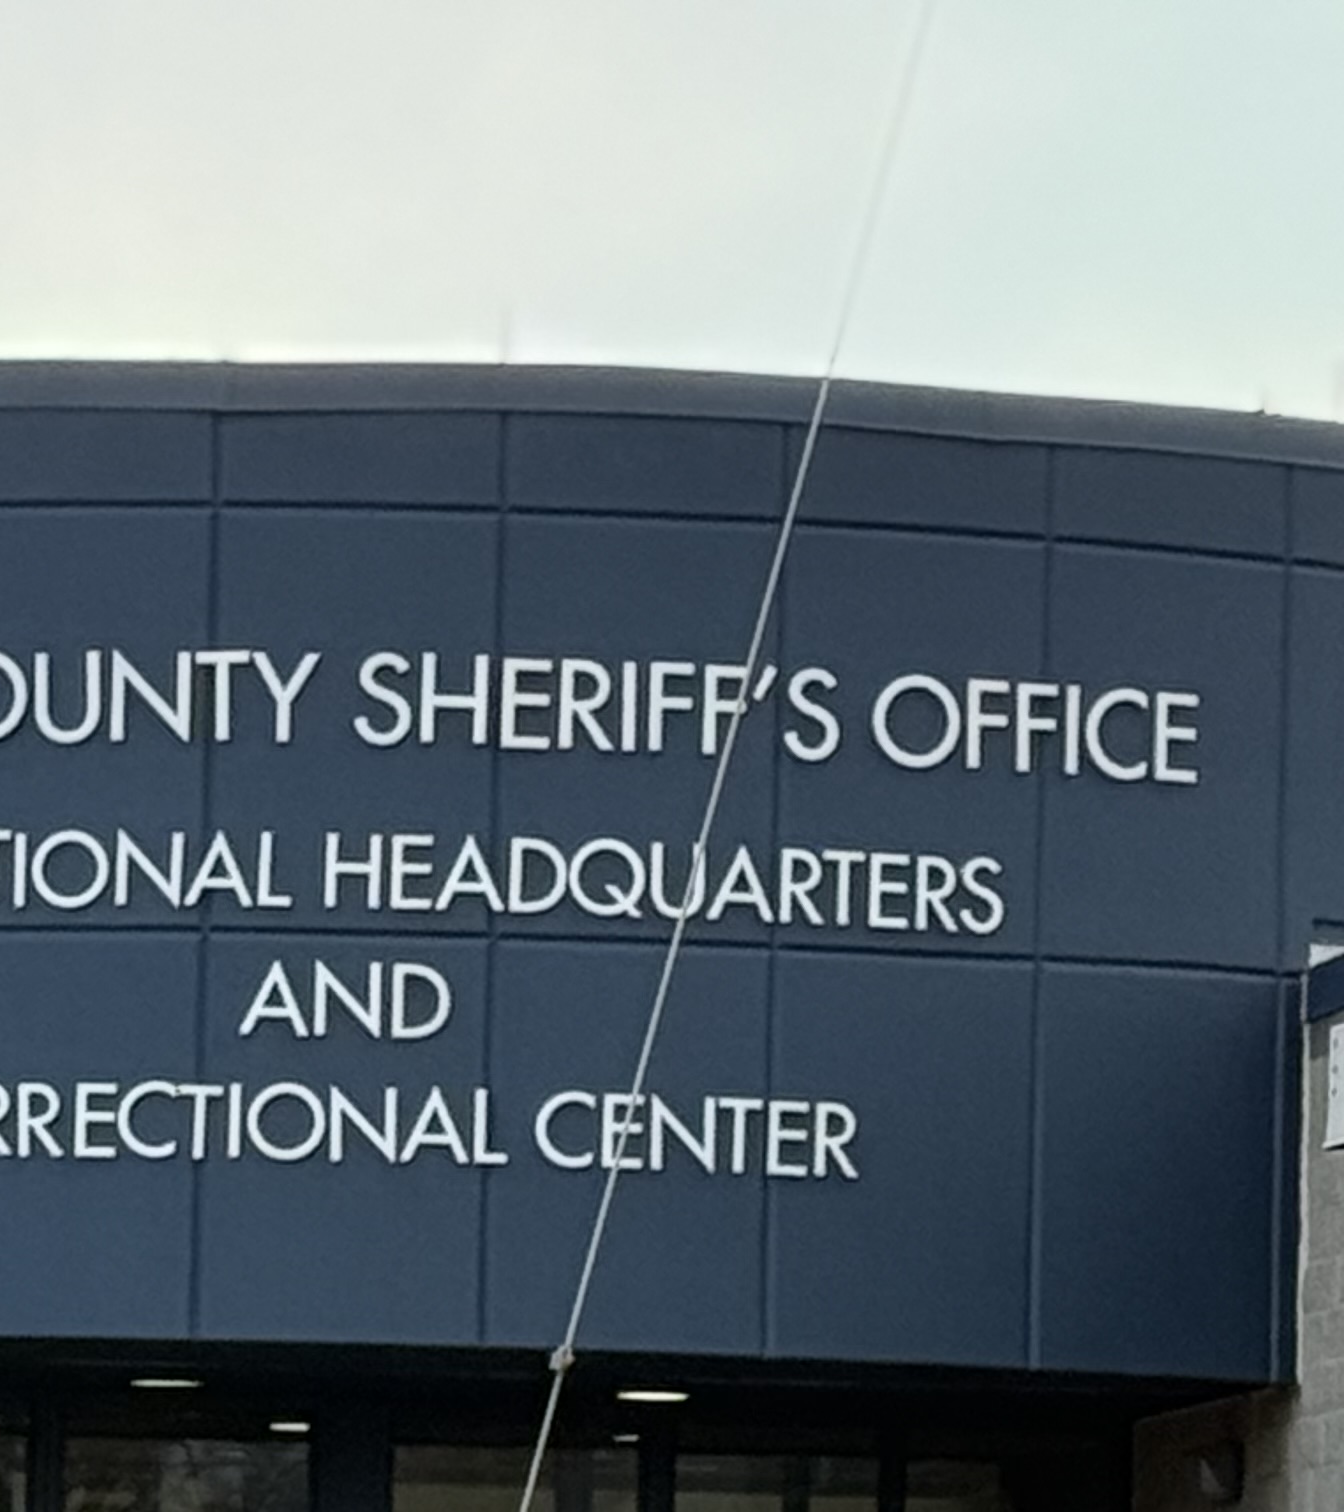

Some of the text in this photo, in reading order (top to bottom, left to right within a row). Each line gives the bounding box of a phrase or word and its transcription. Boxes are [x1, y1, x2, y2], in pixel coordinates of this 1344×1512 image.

[352, 650, 841, 762] SHERIFF'S
[871, 673, 1201, 784] OFFICE
[322, 830, 1005, 935] HEADQUARTERS
[238, 958, 452, 1040] AND
[533, 1089, 859, 1180] CENTER
